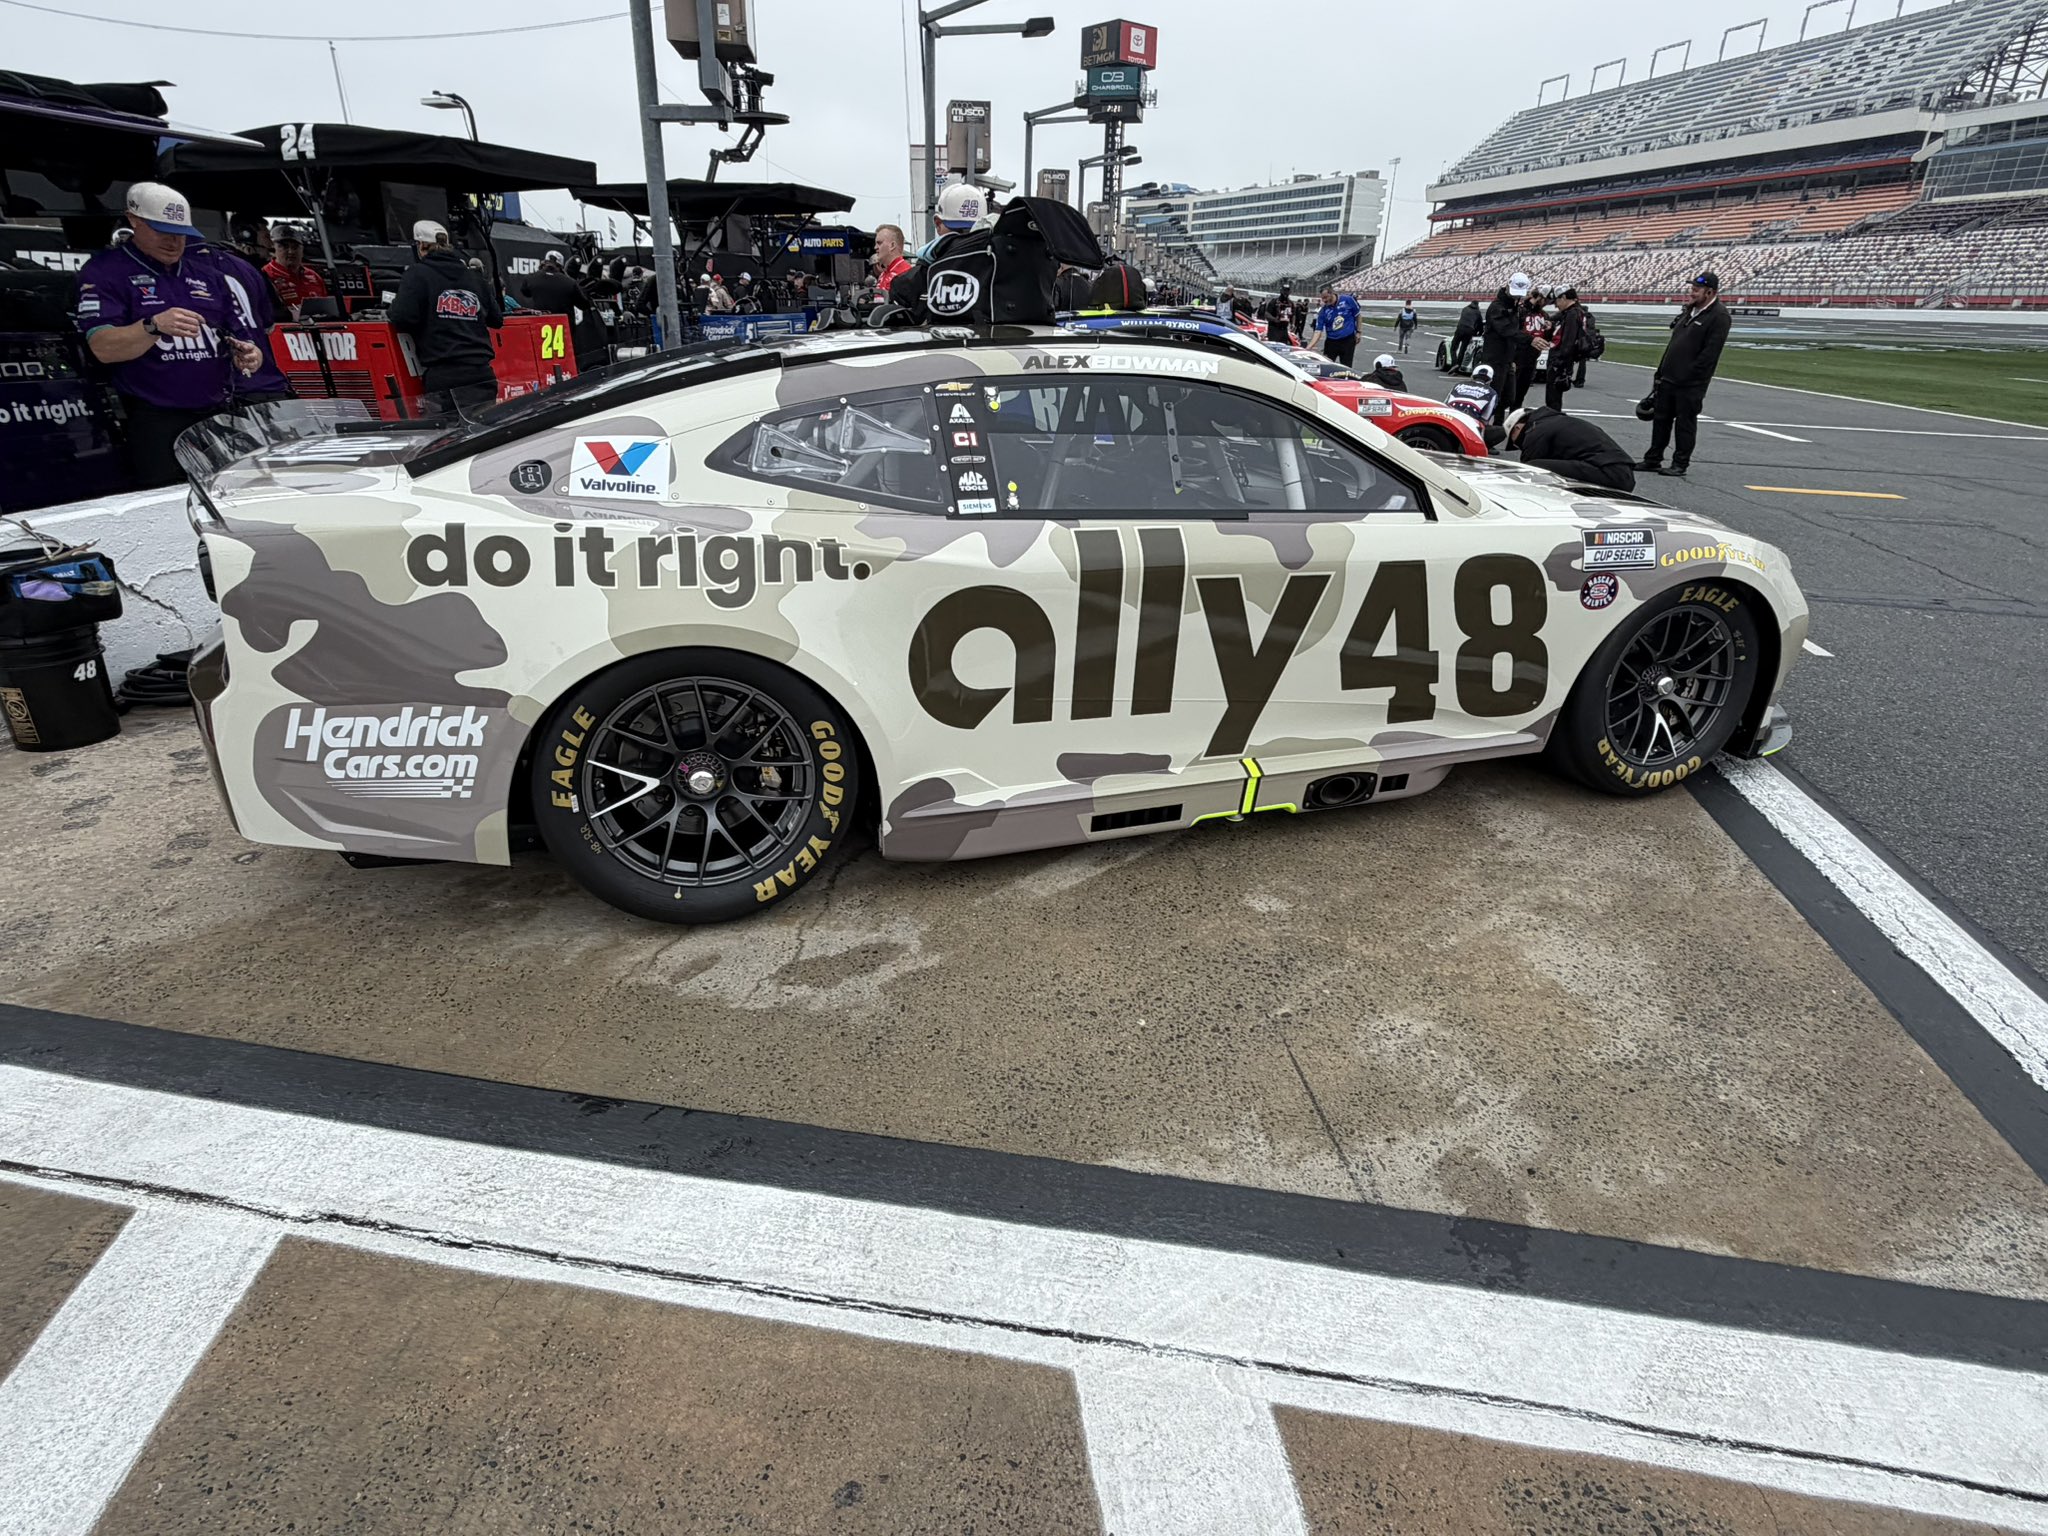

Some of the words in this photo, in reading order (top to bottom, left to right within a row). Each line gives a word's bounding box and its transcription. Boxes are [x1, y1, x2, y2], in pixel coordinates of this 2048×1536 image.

[1083, 50, 1115, 66] BETMGM
[1127, 55, 1147, 65] TOYOTA
[280, 123, 316, 161] 24
[959, 200, 979, 218] 48
[803, 238, 821, 247] AUTO
[822, 238, 844, 247] PARTS
[507, 257, 540, 275] JGR
[929, 275, 973, 304] Arai
[436, 294, 477, 317] KBM
[1166, 321, 1200, 330] BYRON
[283, 331, 358, 361] RATOR
[541, 324, 565, 360] 24
[11, 401, 33, 422] it
[33, 399, 94, 425] right.
[580, 477, 656, 495] Valvoline
[958, 470, 988, 486] MAC
[962, 502, 992, 510] SIEMENS
[1607, 531, 1645, 544] NASCAR
[407, 522, 531, 588] do
[553, 522, 616, 588] it
[1593, 549, 1613, 562] CUP
[1614, 548, 1646, 561] SERIES
[1660, 543, 1767, 572] GOODYEAR
[1587, 575, 1615, 588] NASCAR
[1678, 586, 1740, 613] EAGLE
[907, 527, 1334, 757] ally
[1340, 552, 1549, 724] 48
[73, 660, 97, 681] 48
[284, 706, 488, 762] Hendrick
[323, 749, 479, 779] Cars.com
[551, 705, 597, 809] EAGLE
[753, 720, 845, 902] GOODYEAR
